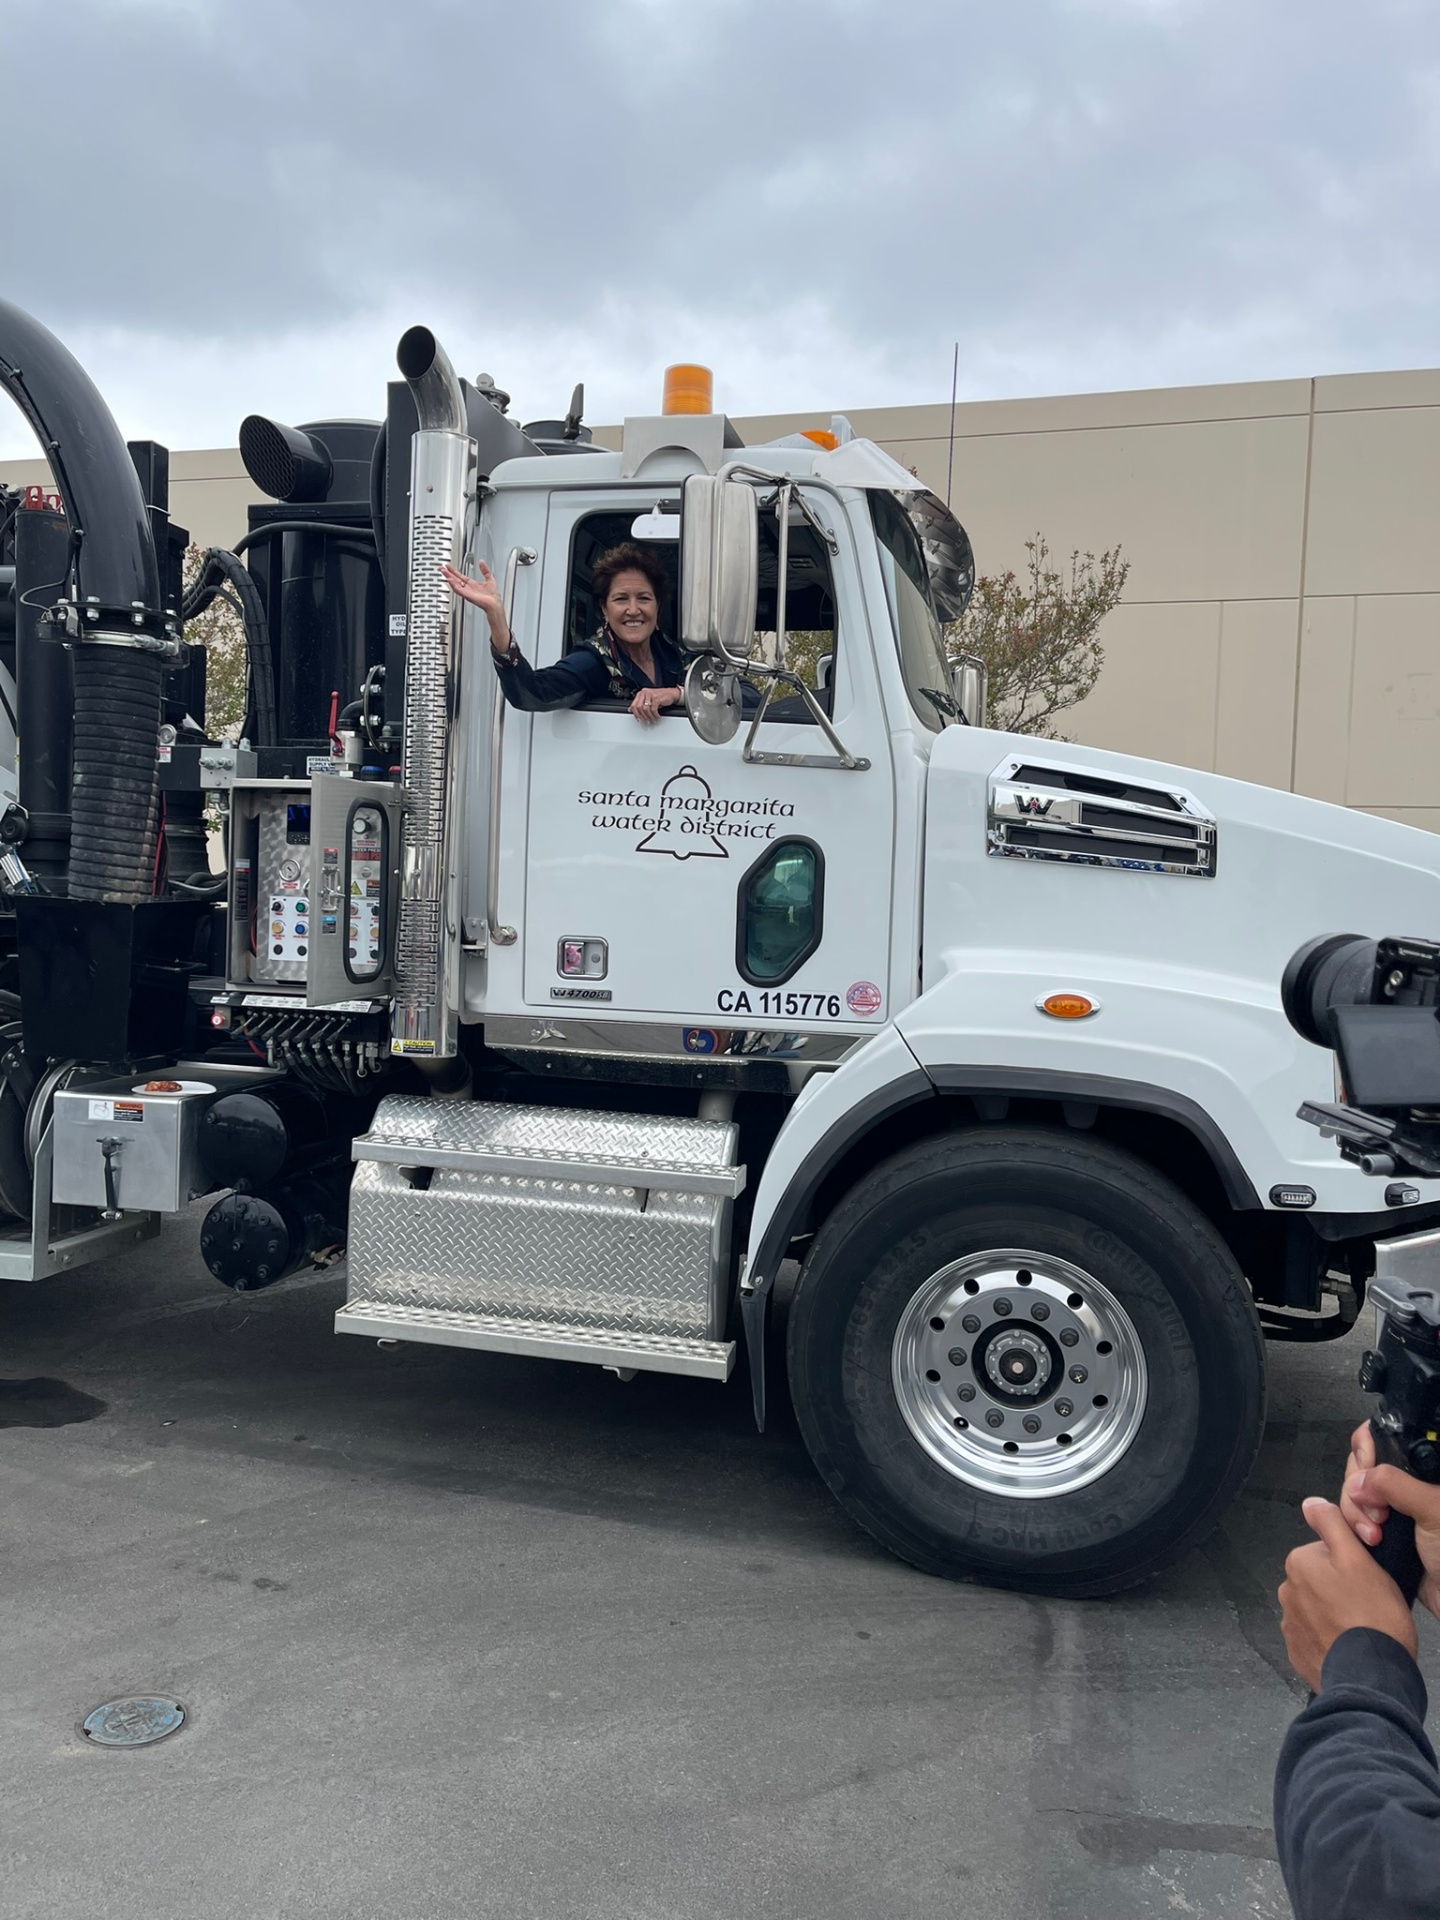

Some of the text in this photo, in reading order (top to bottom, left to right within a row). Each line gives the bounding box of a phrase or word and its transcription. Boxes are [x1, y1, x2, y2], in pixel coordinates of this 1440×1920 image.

[578, 791, 795, 818] santa margarita
[592, 814, 776, 839] water district
[717, 989, 752, 1013] CA
[760, 991, 840, 1017] 115776
